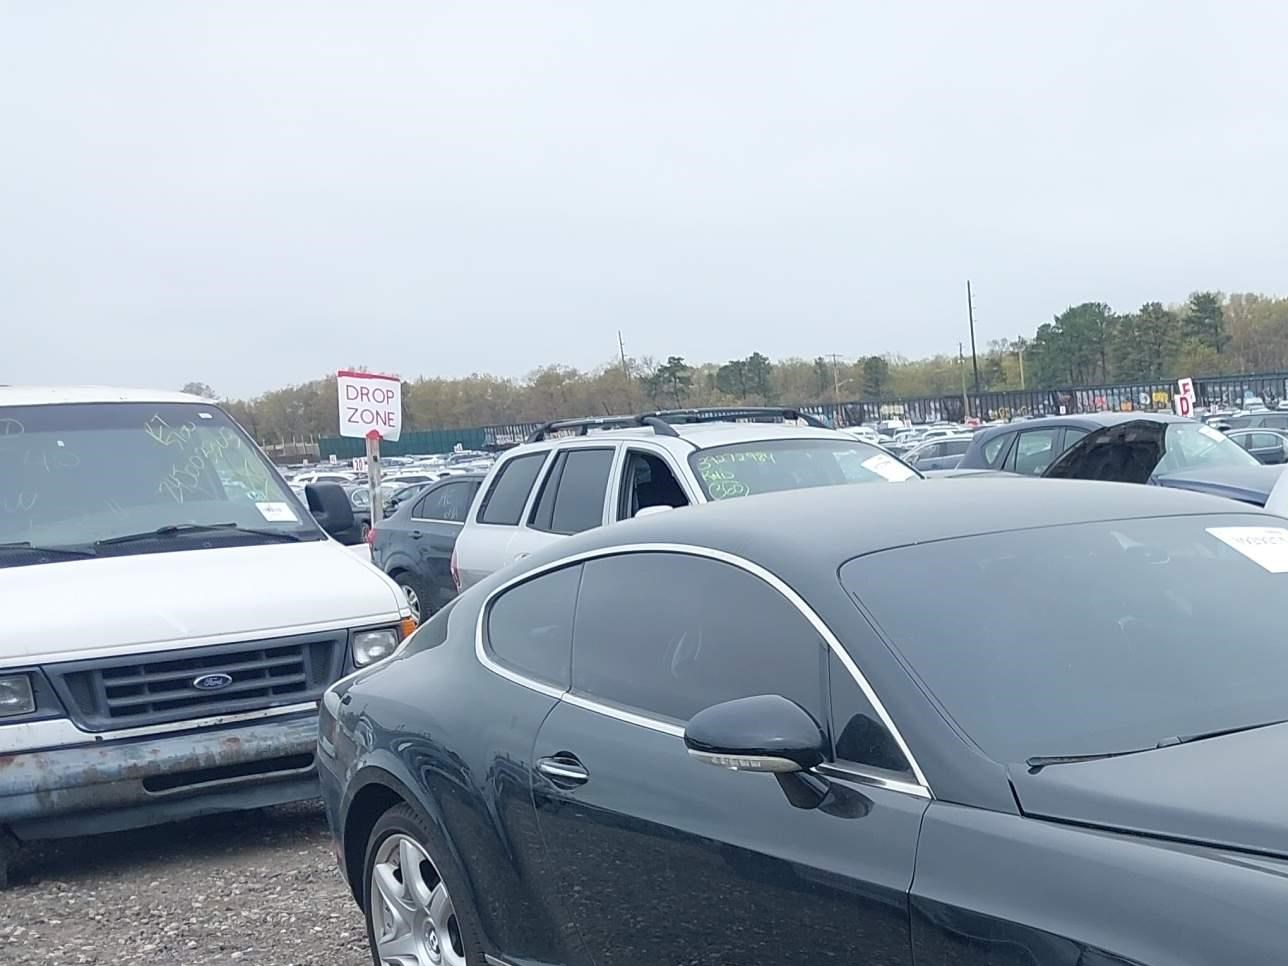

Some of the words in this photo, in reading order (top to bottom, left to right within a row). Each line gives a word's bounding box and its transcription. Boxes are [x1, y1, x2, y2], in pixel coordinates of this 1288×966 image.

[346, 384, 395, 405] DROP
[1180, 396, 1190, 416] D
[347, 407, 396, 428] ZONE
